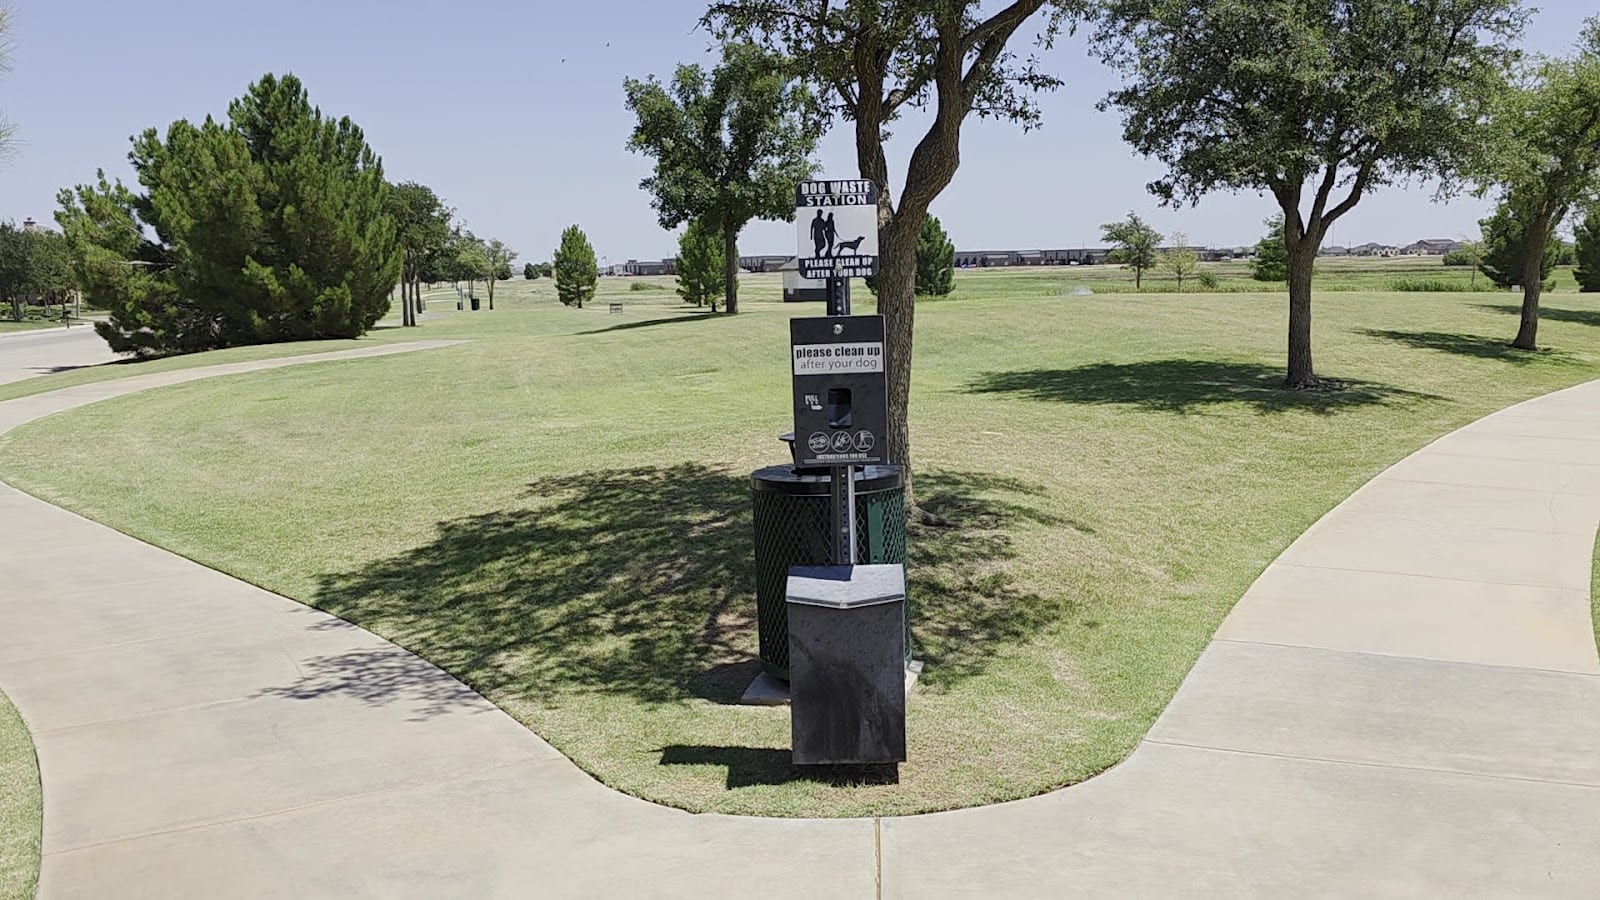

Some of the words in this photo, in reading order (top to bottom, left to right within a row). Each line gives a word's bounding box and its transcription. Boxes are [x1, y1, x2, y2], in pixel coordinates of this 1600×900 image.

[801, 182, 826, 194] DOG
[830, 181, 870, 194] WASTE
[806, 195, 867, 206] STATION
[804, 259, 834, 267] PLEASE
[836, 257, 860, 267] CLEAN
[862, 257, 873, 265] UP
[806, 269, 831, 278] AFTER
[833, 268, 854, 277] YOUR
[855, 268, 873, 276] DOG
[796, 348, 832, 359] please
[834, 346, 864, 357] clean
[867, 346, 880, 356] up
[800, 359, 825, 369] after
[828, 360, 853, 370] your
[855, 358, 877, 369] dog
